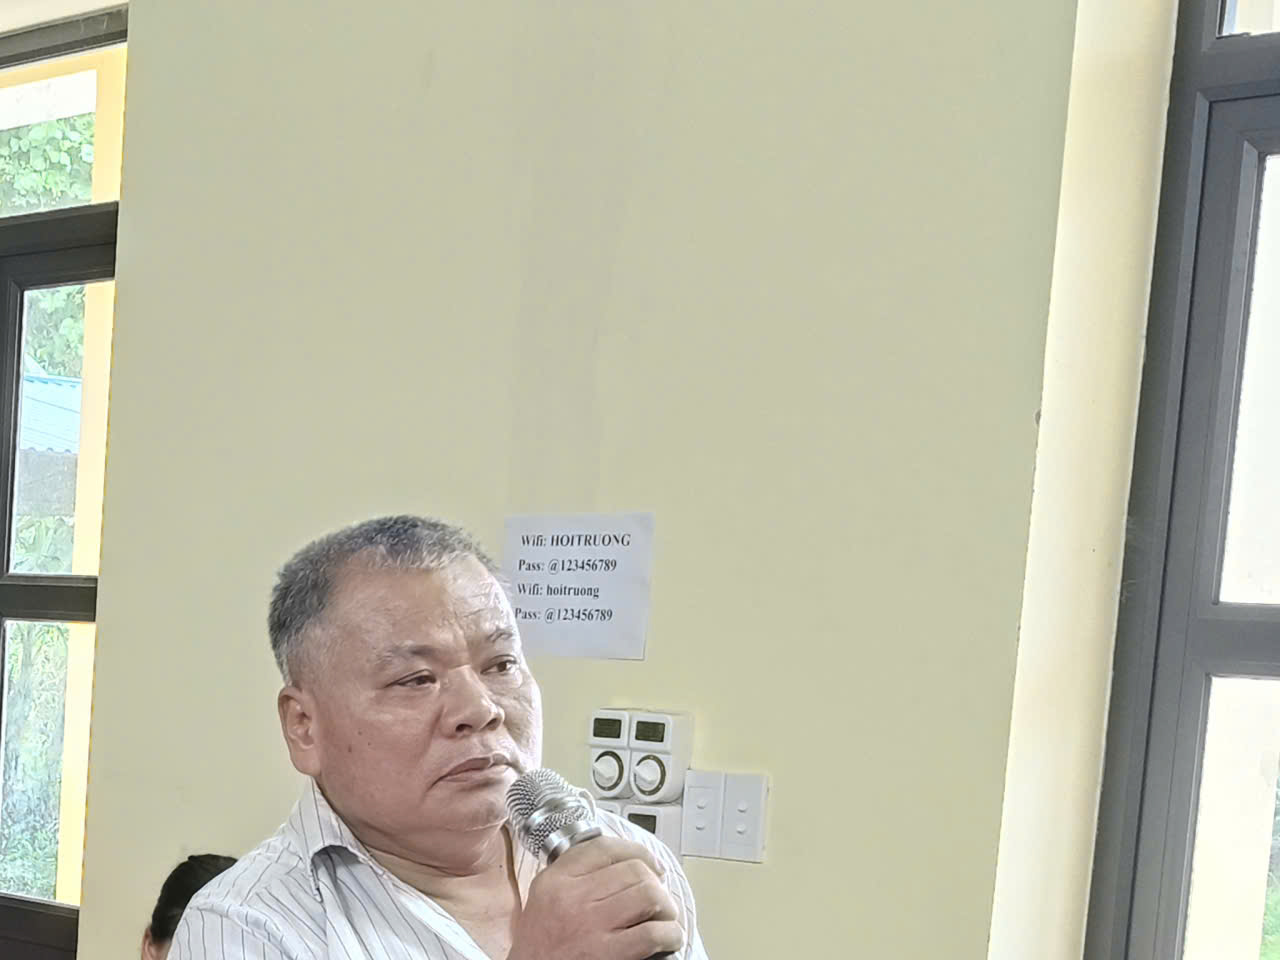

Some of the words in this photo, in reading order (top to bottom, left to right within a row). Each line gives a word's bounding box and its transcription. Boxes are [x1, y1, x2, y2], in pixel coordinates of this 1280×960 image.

[521, 535, 547, 547] Wifi:
[551, 534, 631, 547] HOITRUONG
[518, 559, 544, 571] Pass:
[548, 558, 617, 575] @123456789
[517, 584, 543, 596] Wifi:
[546, 584, 600, 599] hoitruong
[514, 608, 541, 620] Pass:
[545, 607, 613, 624] @123456789
